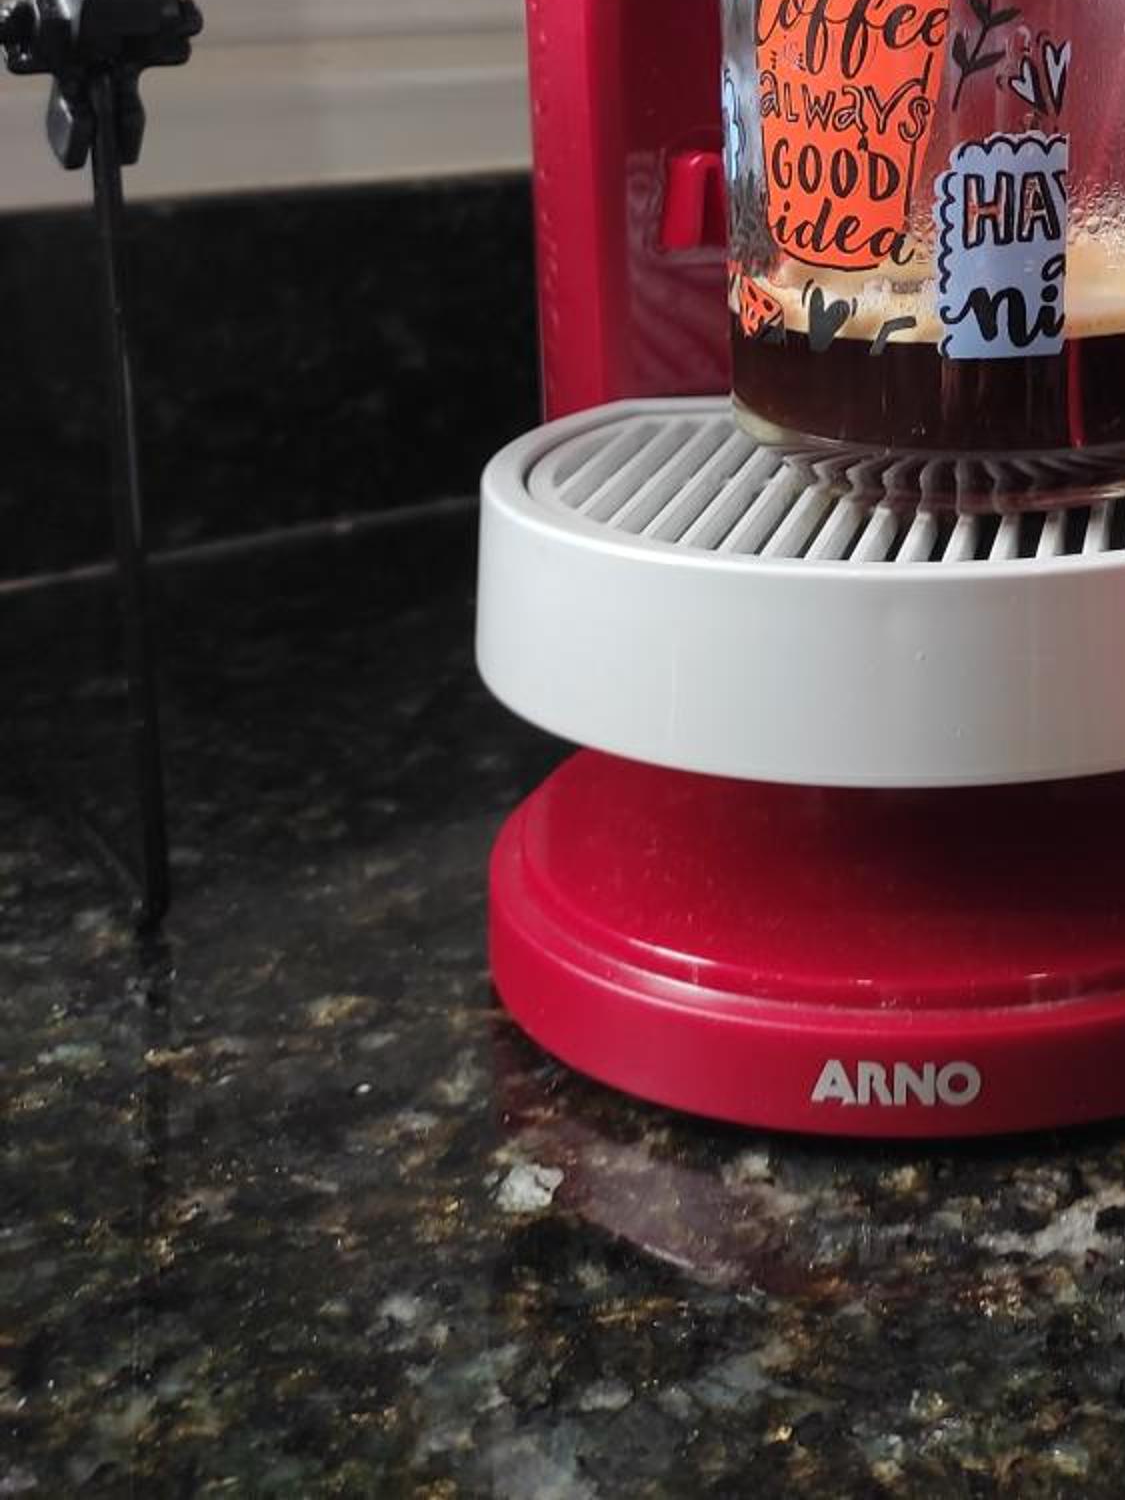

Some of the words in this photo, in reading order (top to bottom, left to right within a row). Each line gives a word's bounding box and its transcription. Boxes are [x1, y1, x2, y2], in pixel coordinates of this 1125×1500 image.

[772, 138, 901, 201] GOOD
[771, 197, 915, 265] idea
[811, 1059, 981, 1107] ARNO
